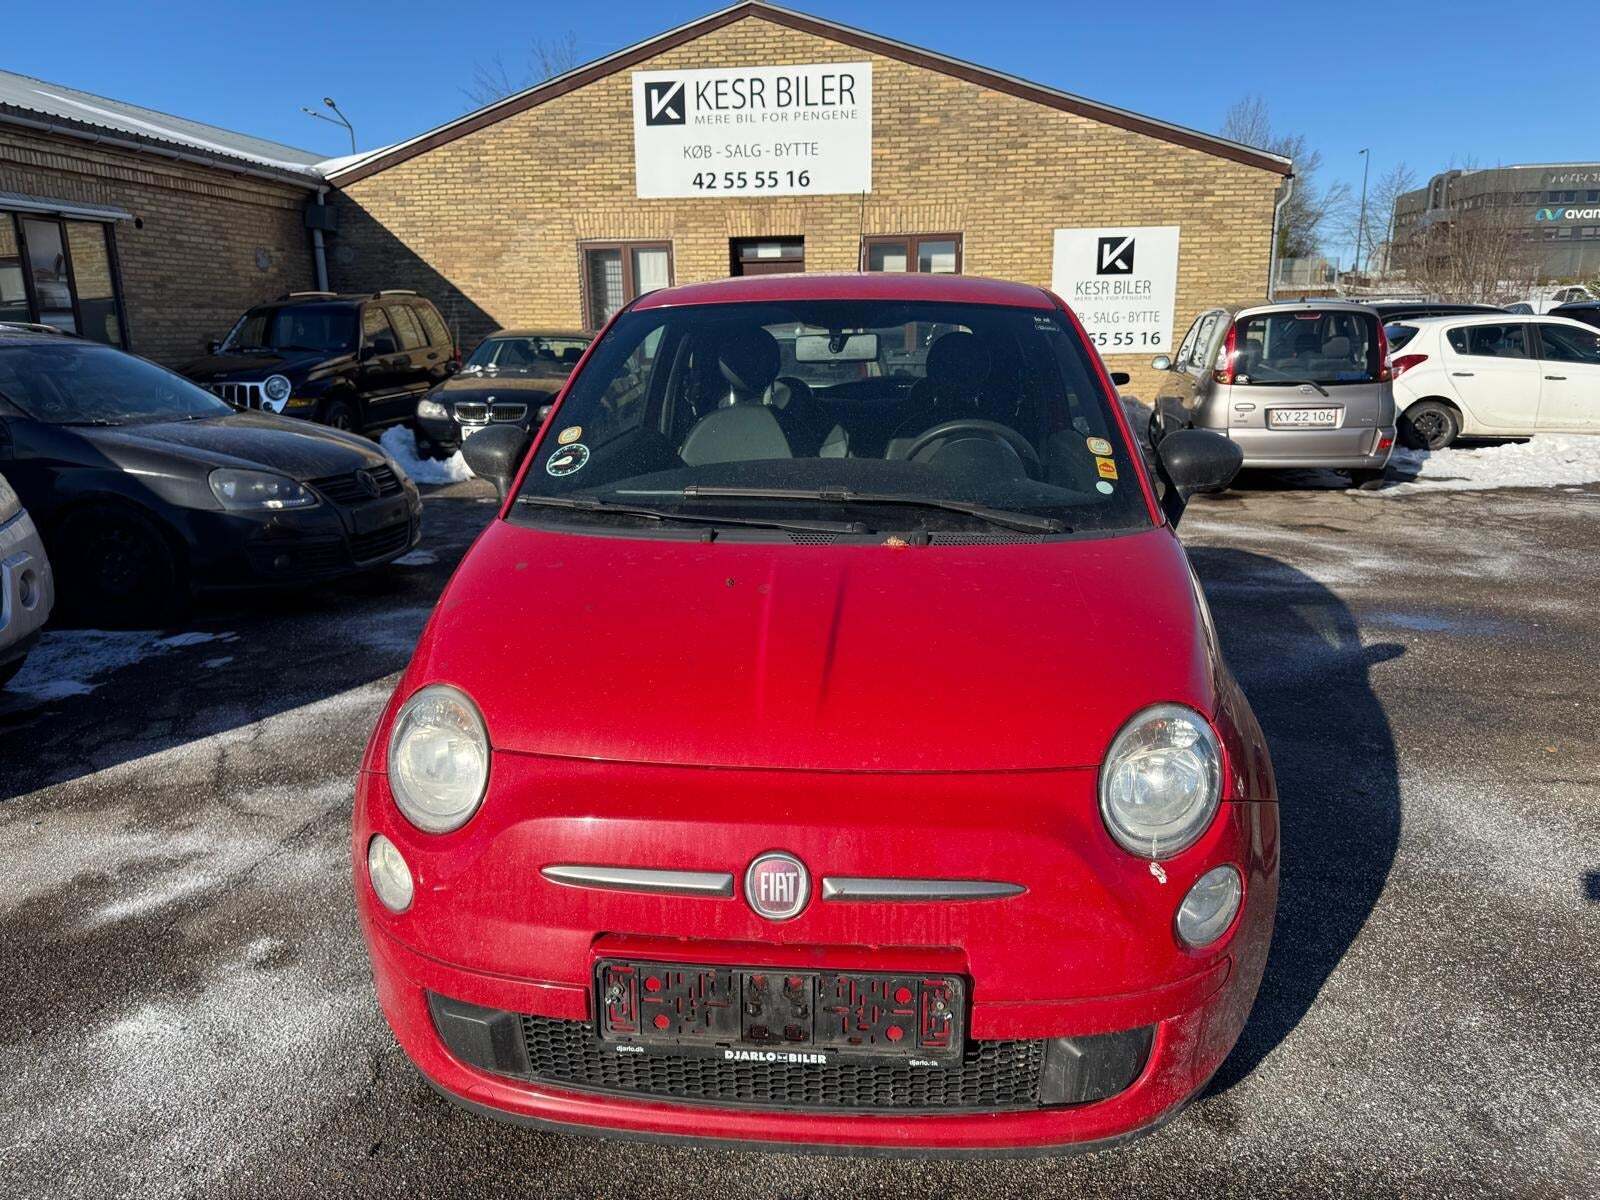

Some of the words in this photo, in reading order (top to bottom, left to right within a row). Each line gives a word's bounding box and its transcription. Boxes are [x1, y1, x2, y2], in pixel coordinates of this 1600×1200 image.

[695, 77, 766, 111] KESR
[776, 73, 856, 108] BILER
[694, 114, 731, 125] MERE
[736, 112, 757, 123] BIL
[761, 111, 788, 122] FOR
[793, 109, 859, 121] PENGENE
[683, 145, 712, 159] KØB
[725, 143, 762, 158] SALG
[774, 142, 819, 157] BYTTE
[692, 172, 717, 189] 42
[723, 171, 748, 189] 55
[754, 170, 779, 188] 55
[785, 169, 811, 187] 16
[1075, 280, 1110, 295] KESR
[1113, 279, 1152, 294] BILER
[1093, 311, 1120, 323] SALG
[1128, 310, 1160, 323] BYTTE
[1112, 332, 1134, 346] 55
[1140, 331, 1161, 345] 16
[1275, 411, 1292, 422] XY
[1294, 411, 1309, 422] 22
[1312, 410, 1333, 422] 106
[760, 871, 798, 903] FIAT
[724, 1050, 776, 1062] DJARLO
[788, 1053, 827, 1064] BILER
